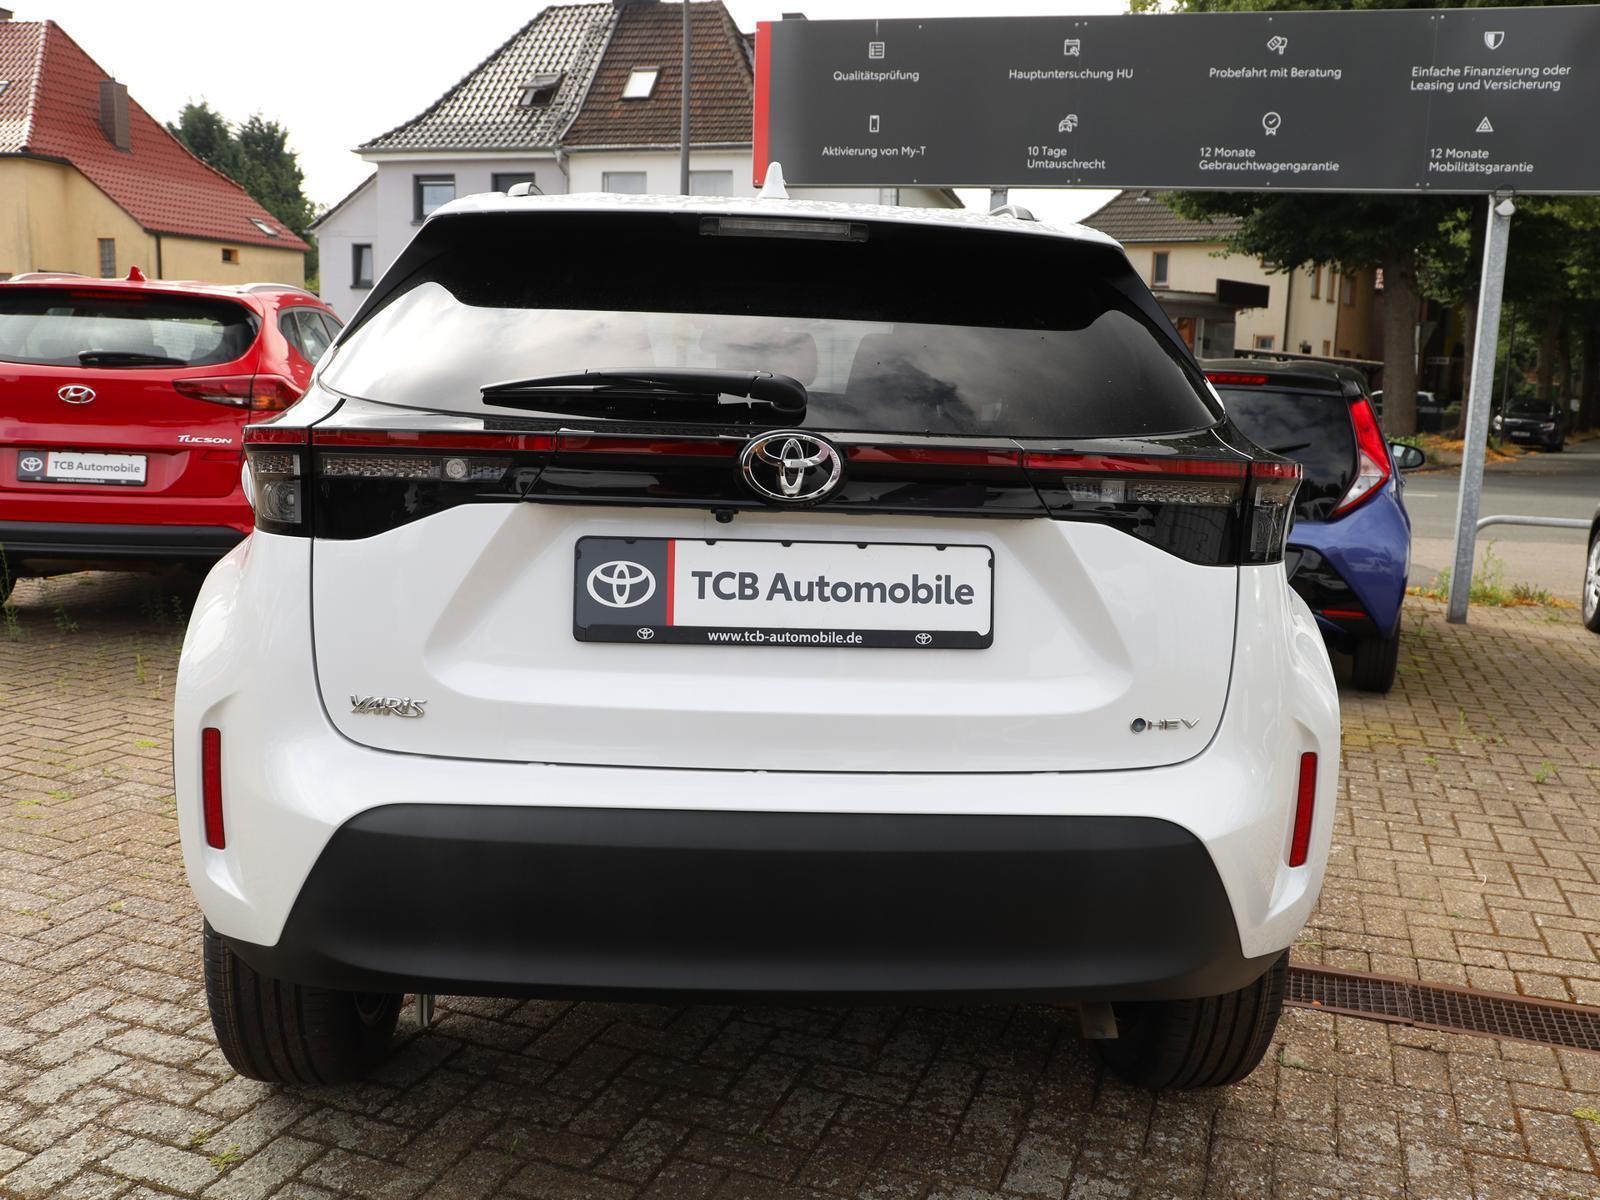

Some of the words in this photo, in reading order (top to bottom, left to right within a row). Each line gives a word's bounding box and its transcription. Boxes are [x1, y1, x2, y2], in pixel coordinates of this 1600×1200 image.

[833, 69, 920, 83] Qualitätsprüfung
[1116, 68, 1134, 79] HU
[1209, 67, 1268, 79] Probefahrt
[1270, 67, 1288, 78] mit
[1290, 67, 1342, 80] Beratung
[1411, 66, 1461, 77] Einfache
[1463, 65, 1539, 78] Finanzierung
[1542, 65, 1572, 76] oder
[1410, 79, 1455, 93] Leasing
[1457, 79, 1481, 91] und
[1483, 78, 1561, 92] Versicherung
[822, 145, 878, 158] Aktivierung
[880, 147, 899, 156] von
[901, 145, 926, 158] My-T
[1027, 145, 1039, 156] 10
[1041, 145, 1067, 158] Tage
[1199, 147, 1212, 157] 12
[1214, 147, 1256, 158] Monate
[1430, 148, 1443, 159] 12
[1445, 148, 1489, 159] Monate
[1027, 158, 1106, 170] Umtauschrecht
[1199, 159, 1340, 173] Gebrauchtwagengarantie
[1429, 161, 1534, 174] Mobilitätsgarantie
[53, 460, 74, 471] TCB
[76, 461, 141, 473] Automobile
[691, 570, 760, 601] TCB
[766, 572, 974, 605] Automobile
[707, 630, 863, 645] www.tcb-automobile.de
[1147, 718, 1200, 730] HEV
